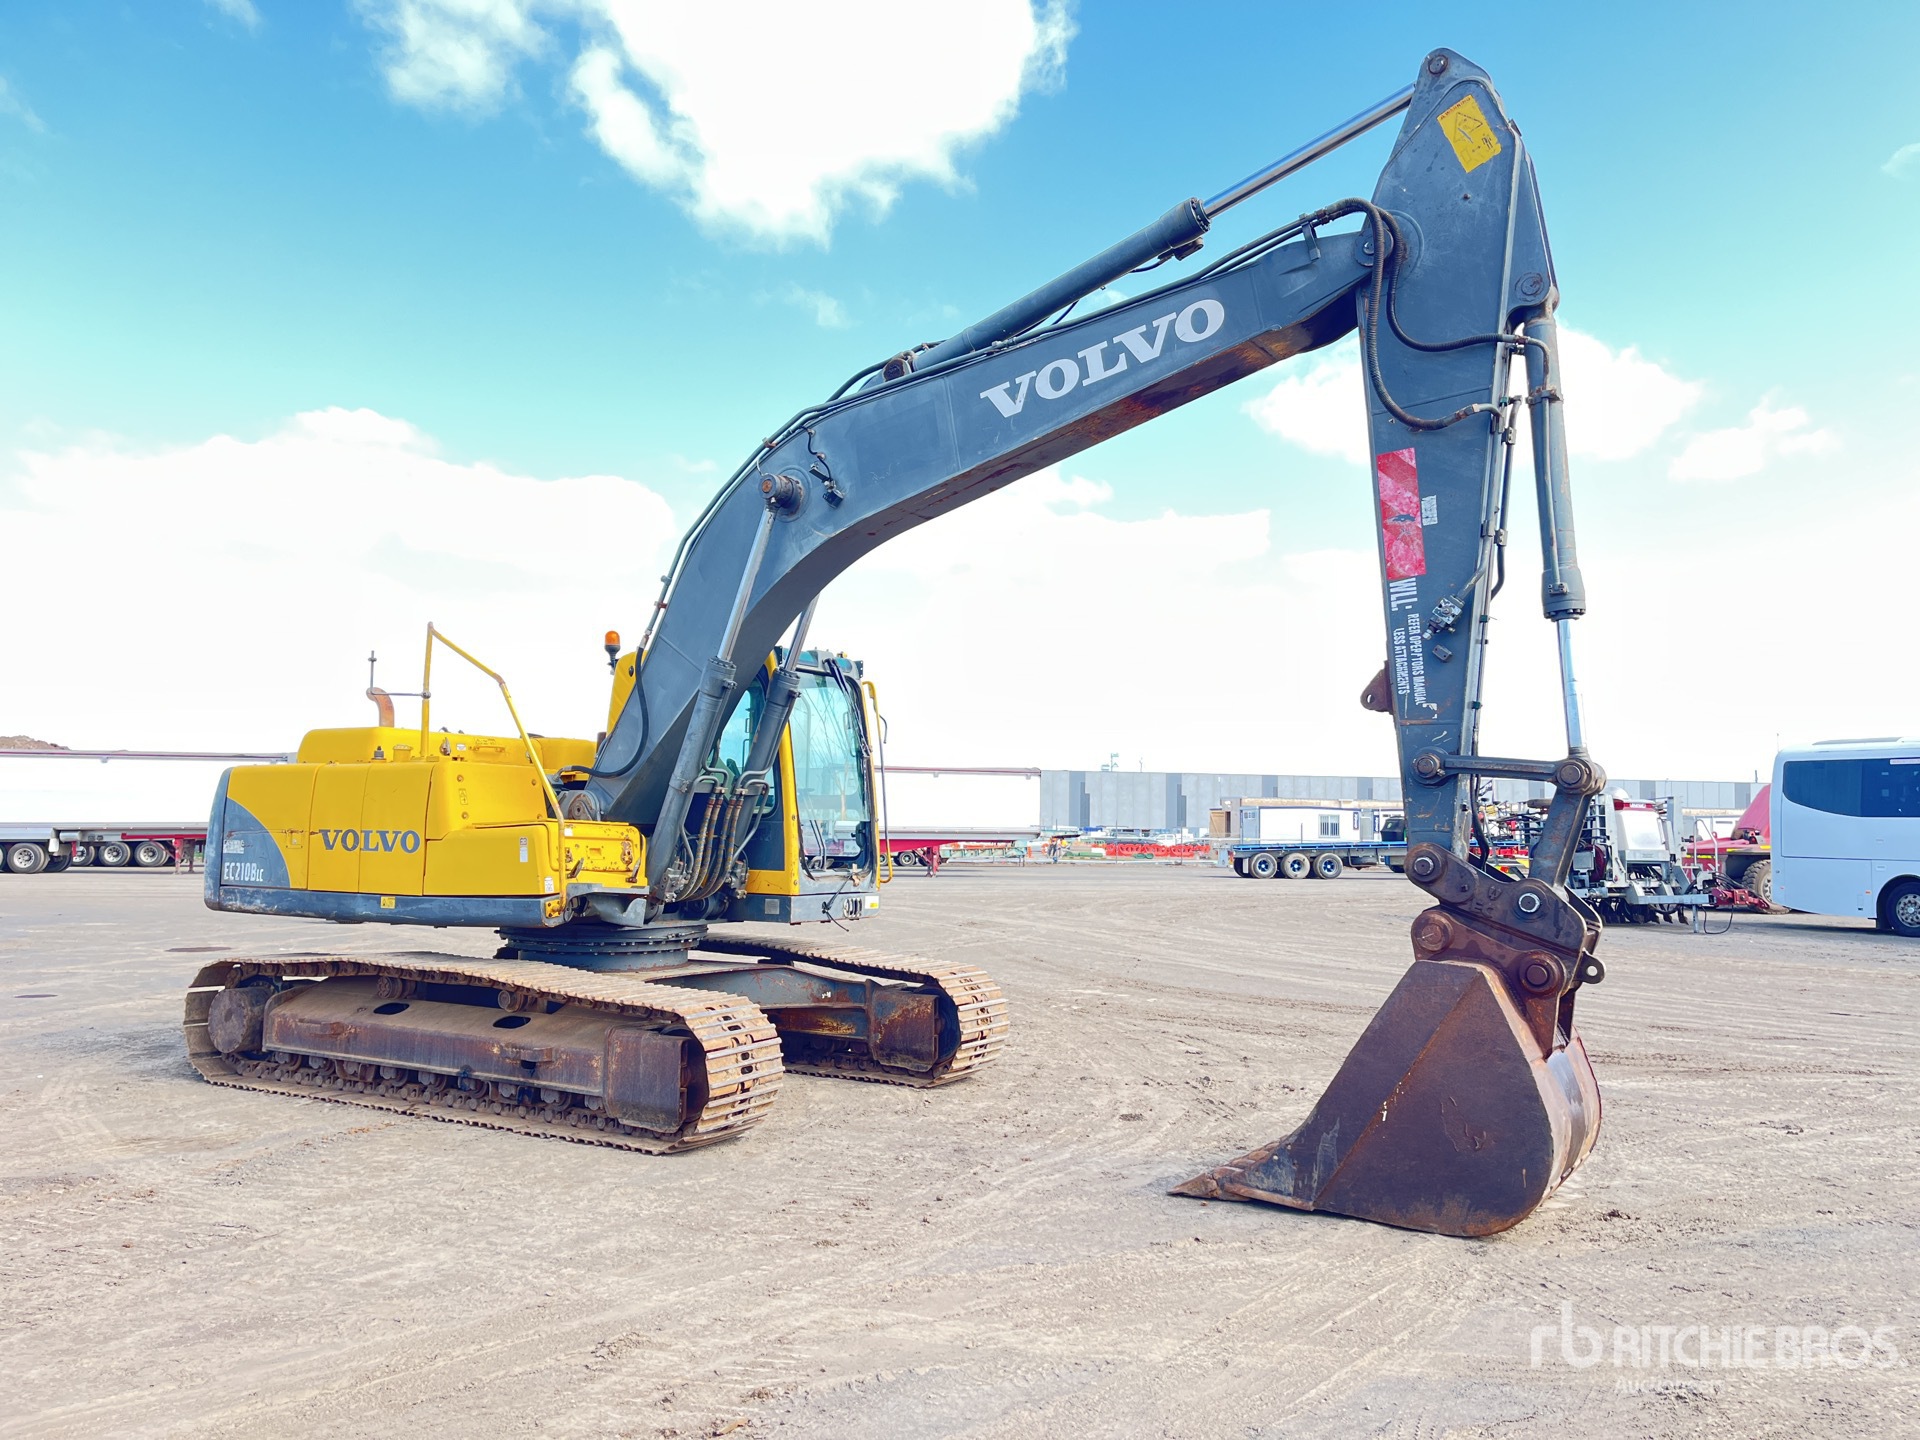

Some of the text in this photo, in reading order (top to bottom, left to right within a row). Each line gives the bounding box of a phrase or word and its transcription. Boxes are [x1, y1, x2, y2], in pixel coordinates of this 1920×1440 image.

[980, 300, 1225, 418] VOLVO
[1389, 577, 1418, 611] WLL:
[1393, 628, 1410, 694] LESS ATTACHMENTS
[1407, 613, 1420, 635] REFER
[1414, 676, 1426, 705] MANUAL
[319, 828, 420, 853] VOLVO
